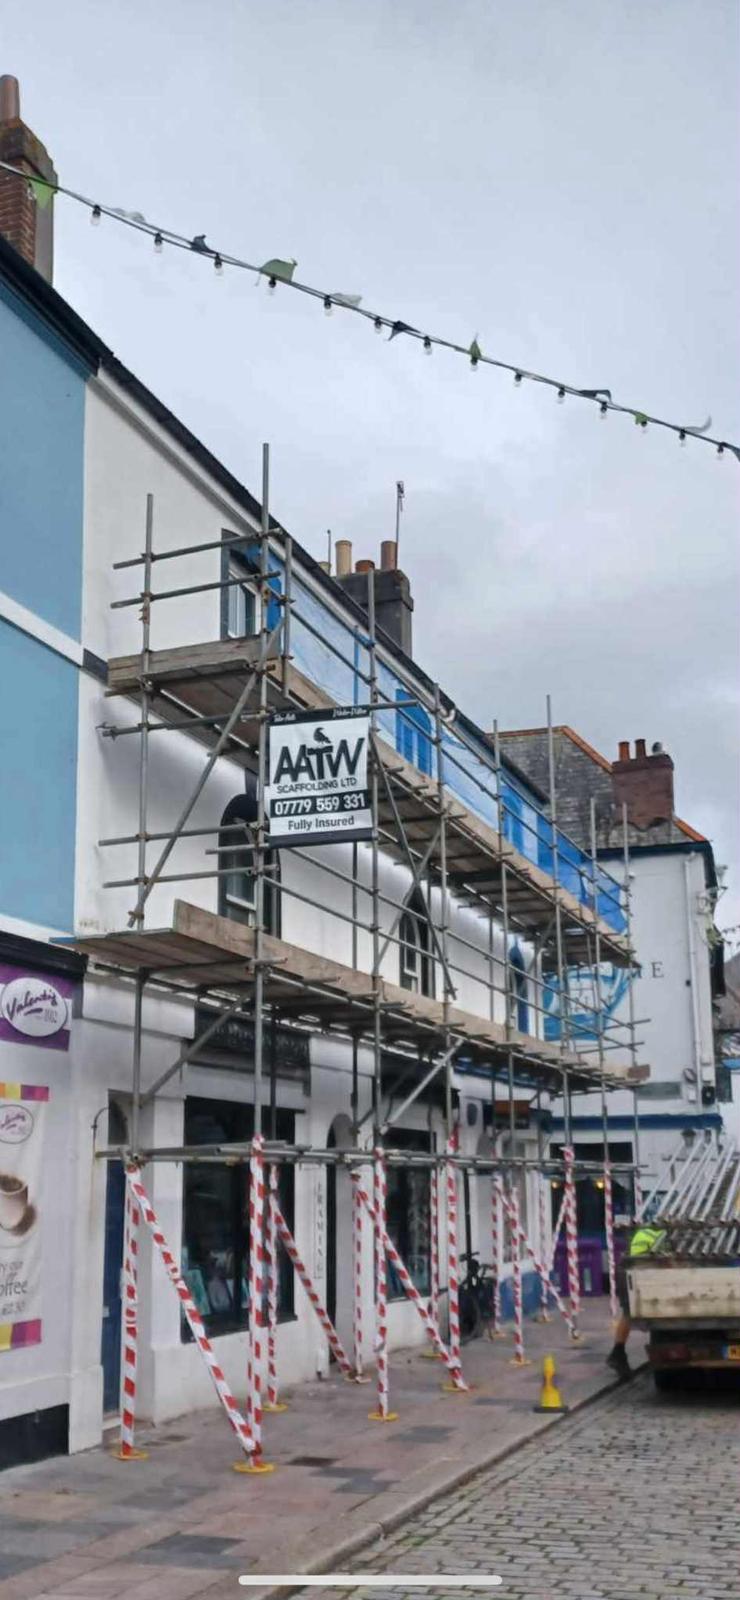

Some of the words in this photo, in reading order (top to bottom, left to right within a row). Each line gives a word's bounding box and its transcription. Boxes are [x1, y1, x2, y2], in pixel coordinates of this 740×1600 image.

[273, 737, 365, 784] AATW
[277, 779, 338, 794] SCAFFOLDING
[340, 777, 357, 788] LTD
[274, 799, 312, 815] 07779
[316, 796, 340, 812] 559
[343, 793, 366, 809] 331
[288, 819, 313, 831] Fully
[315, 816, 355, 828] Insured
